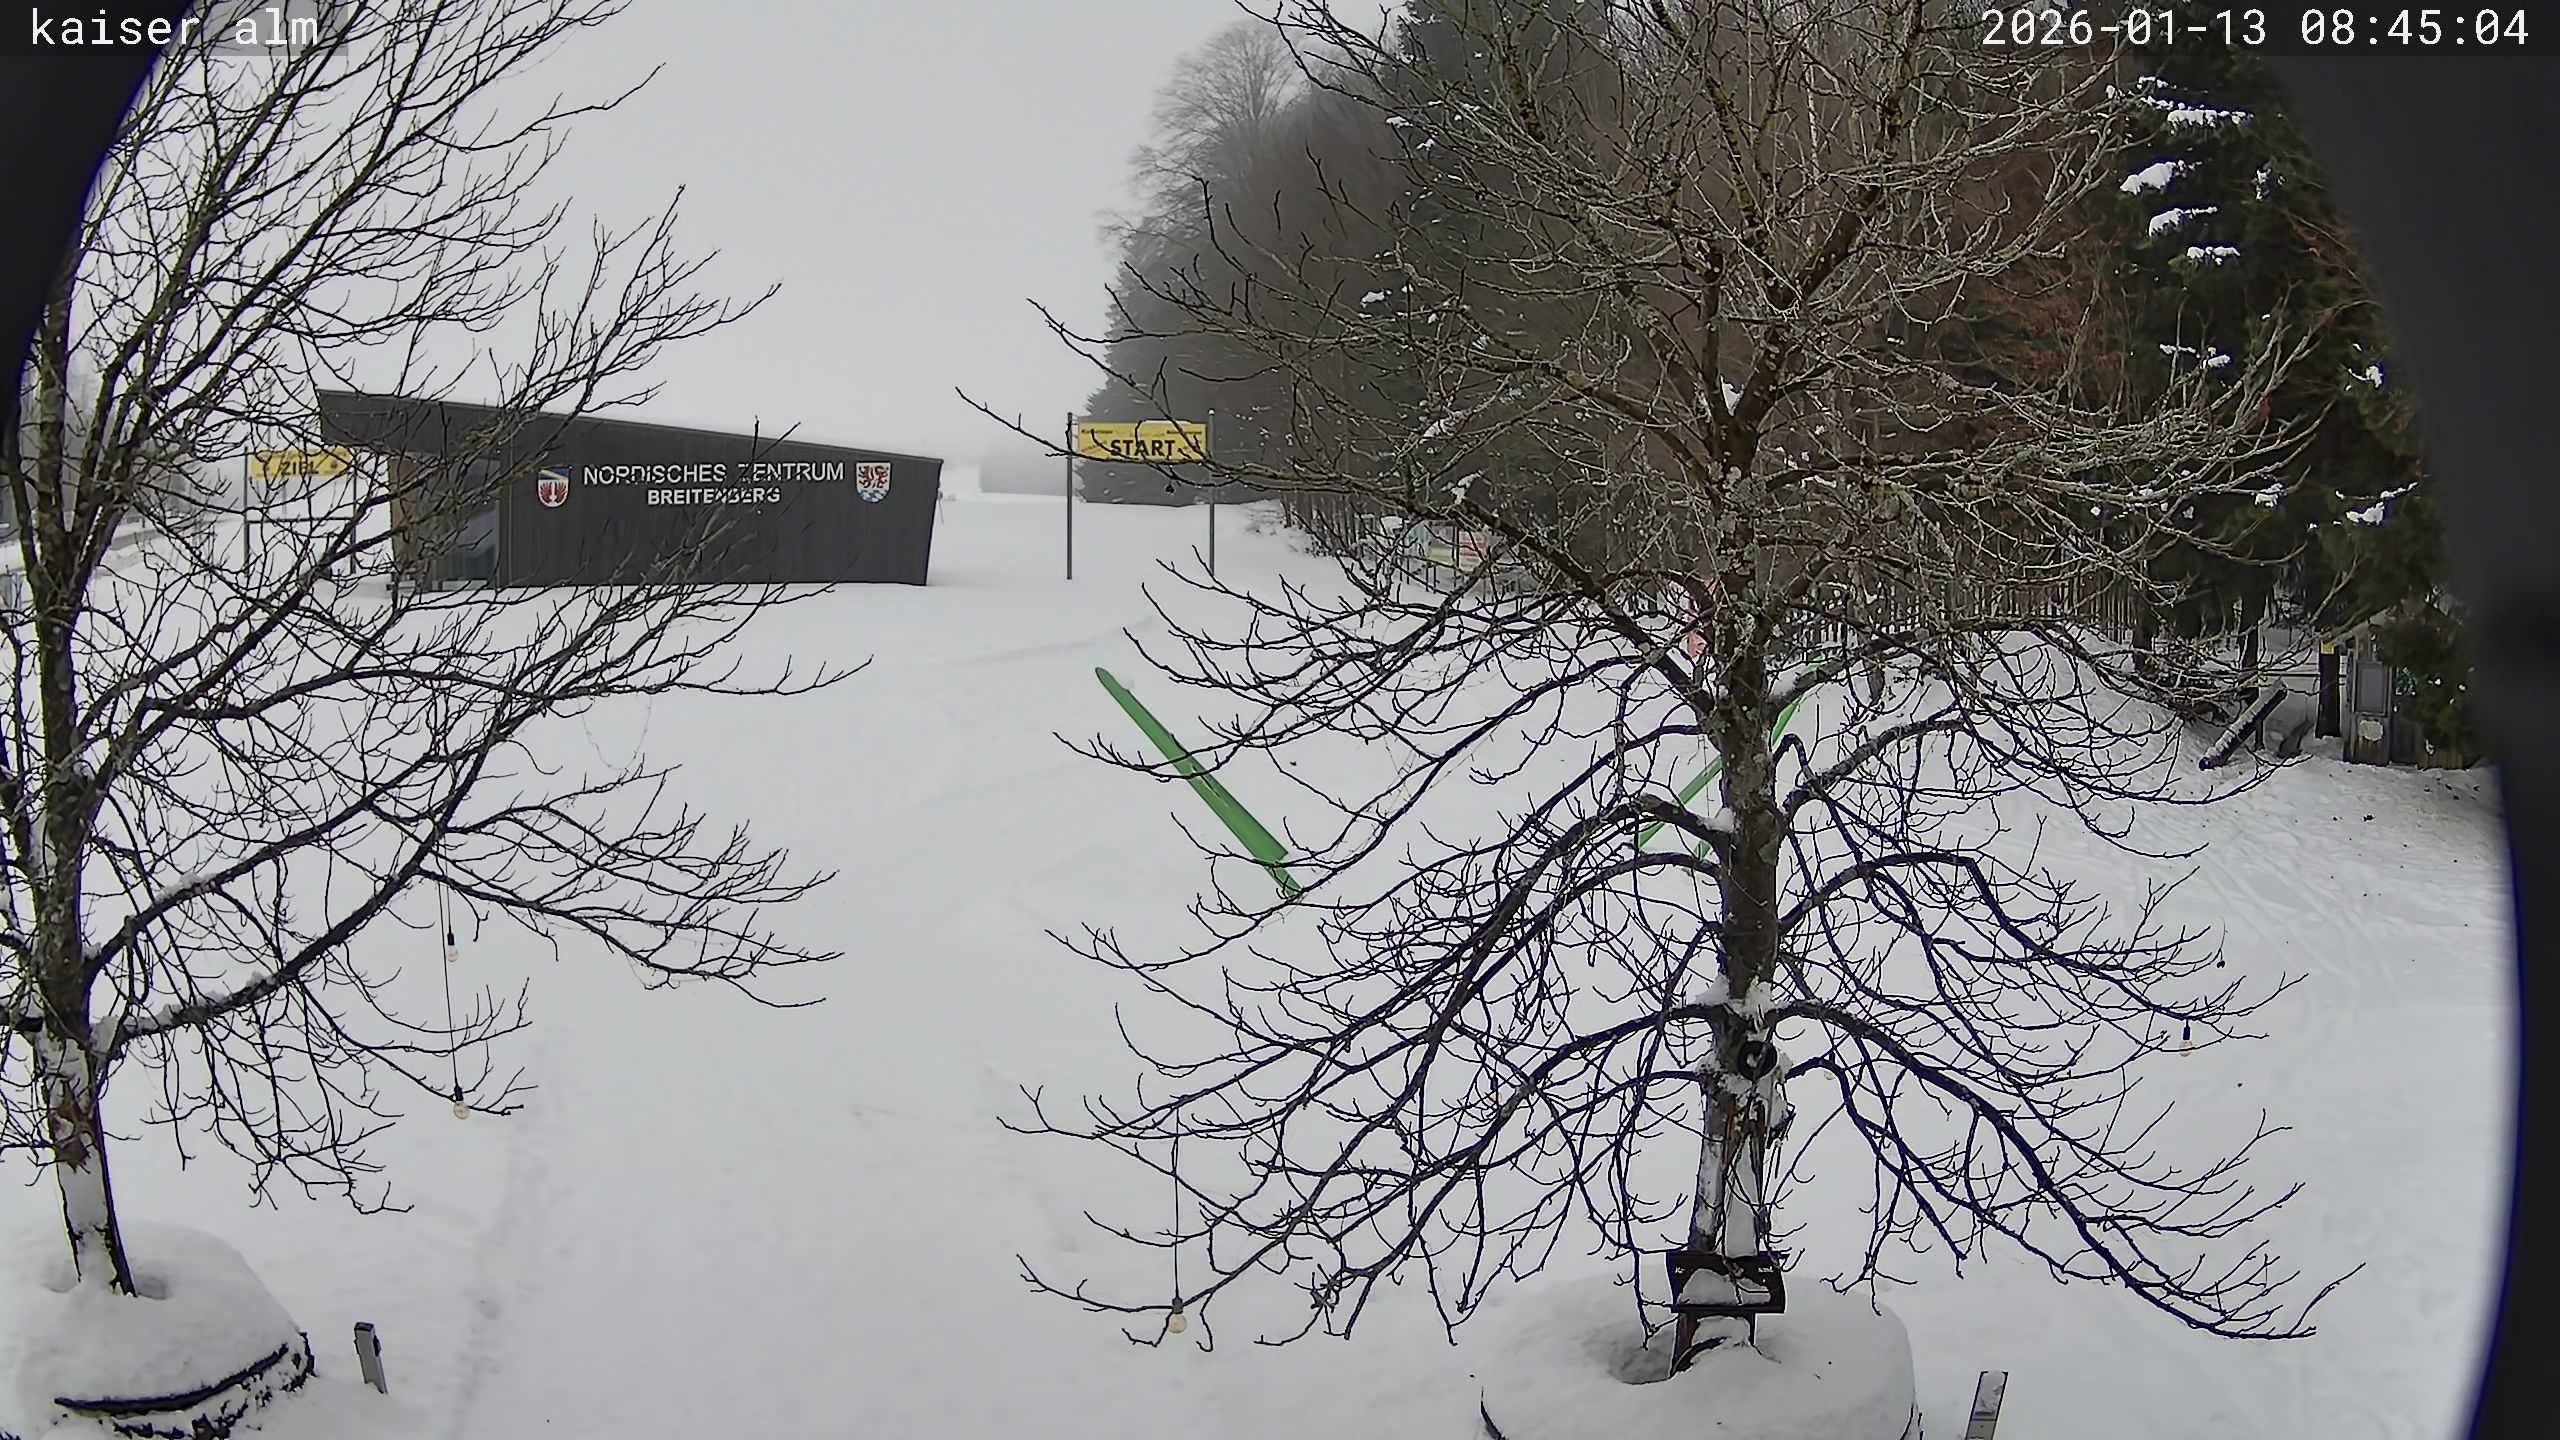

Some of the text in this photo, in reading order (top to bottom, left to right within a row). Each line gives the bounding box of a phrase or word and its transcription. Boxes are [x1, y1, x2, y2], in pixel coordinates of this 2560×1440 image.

[1110, 439, 1176, 457] START
[583, 463, 727, 485] NORDISCHES
[647, 487, 781, 505] BREITENBERG
